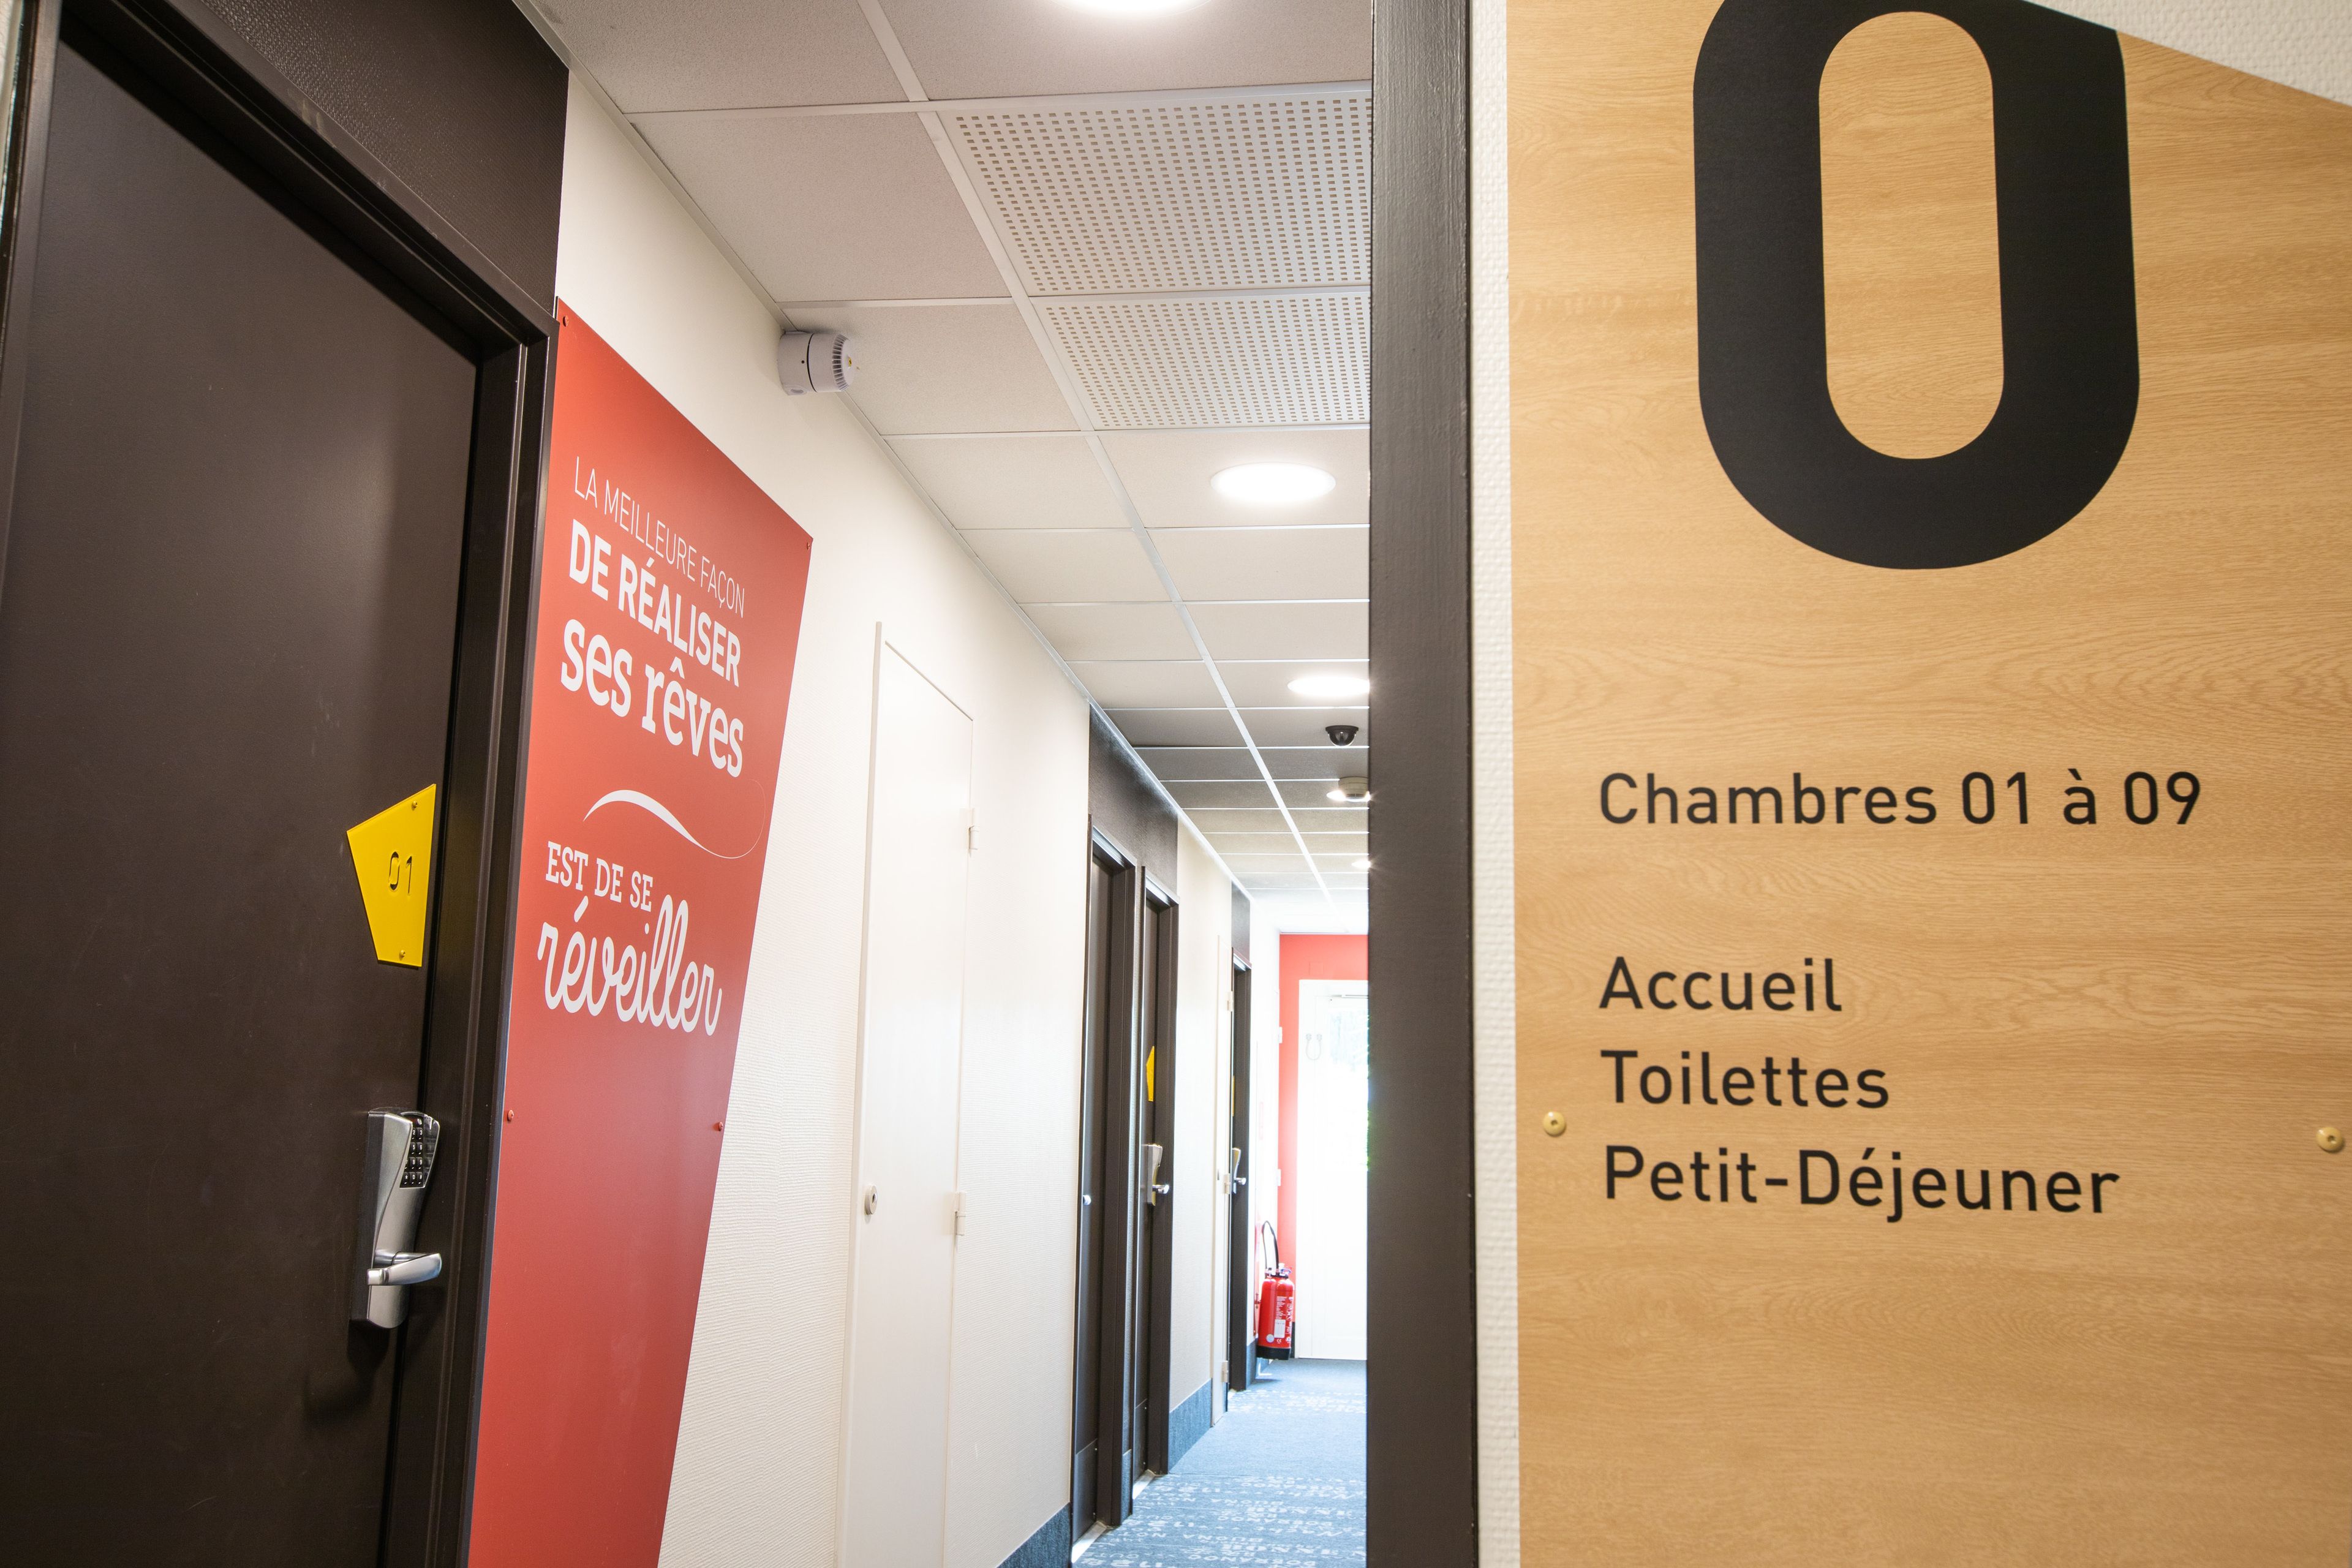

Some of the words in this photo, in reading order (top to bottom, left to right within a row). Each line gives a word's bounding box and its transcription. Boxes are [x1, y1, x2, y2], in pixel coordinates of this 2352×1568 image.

[574, 456, 598, 509] LA
[604, 479, 697, 582] MEILLEURE
[700, 556, 745, 618] FAÇON
[568, 518, 612, 601] DE
[617, 553, 741, 688] RÉALISER
[560, 619, 633, 718] ses
[641, 656, 744, 778] rêves
[1601, 772, 1937, 824] Chambres
[1962, 771, 2028, 824] 01
[2063, 768, 2097, 825] à
[2124, 771, 2201, 825] 09
[388, 851, 413, 896] 01
[546, 841, 589, 891] EST
[594, 858, 624, 903] DE
[630, 870, 654, 912] SE
[537, 894, 723, 1036] réveiller
[1599, 956, 1842, 1011] Accueil
[1600, 1050, 1889, 1109] Toilettes
[1606, 1145, 2120, 1223] Petit-Déjeuner
